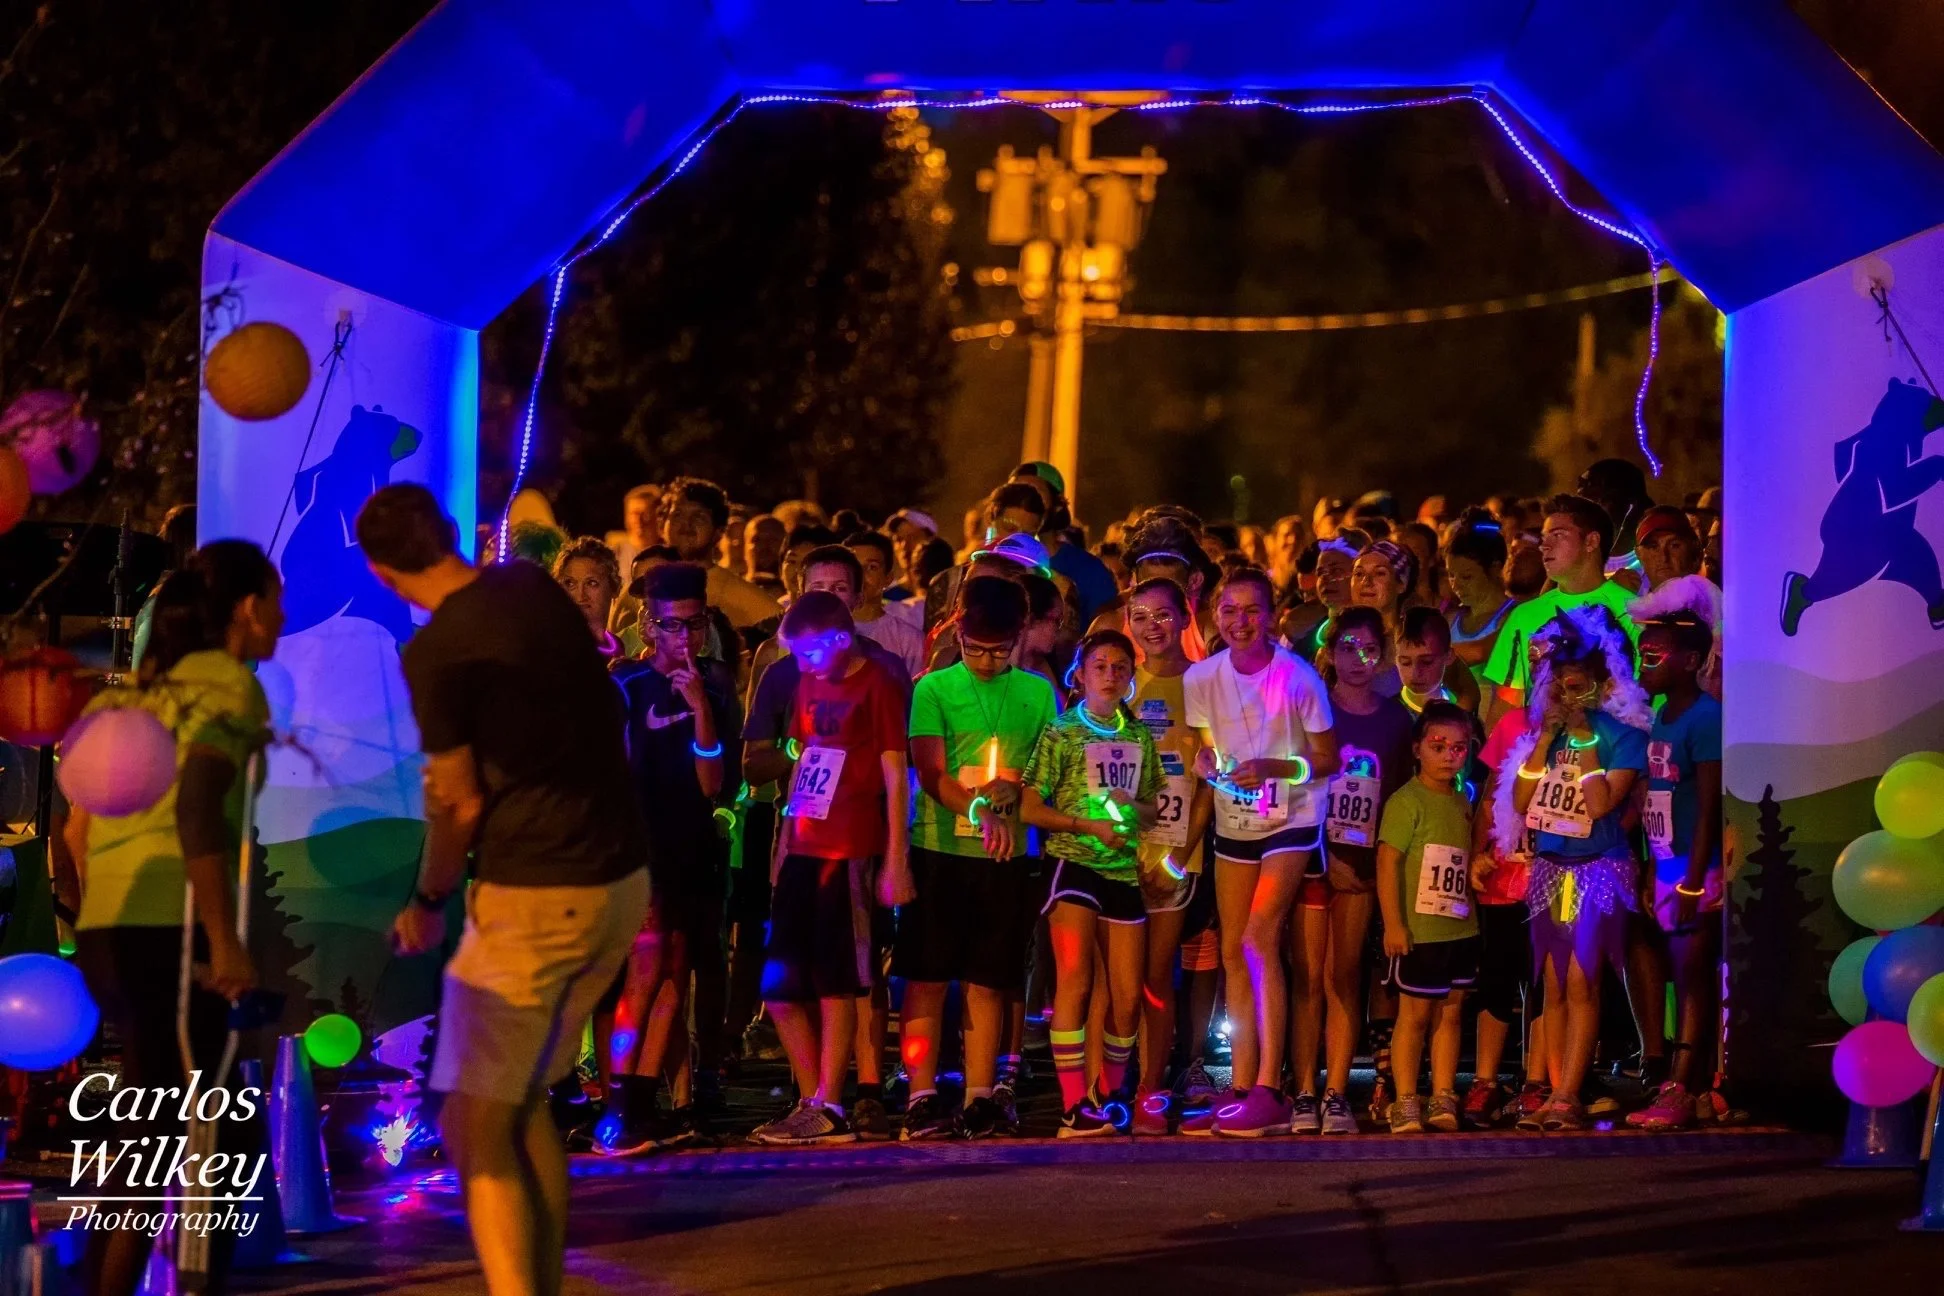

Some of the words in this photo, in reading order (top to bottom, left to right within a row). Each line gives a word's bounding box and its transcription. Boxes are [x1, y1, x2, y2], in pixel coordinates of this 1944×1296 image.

[1096, 762, 1136, 789] 1807
[1156, 795, 1183, 821] 23
[1327, 793, 1372, 823] 1883
[1643, 811, 1665, 838] 00
[1429, 865, 1465, 894] 186
